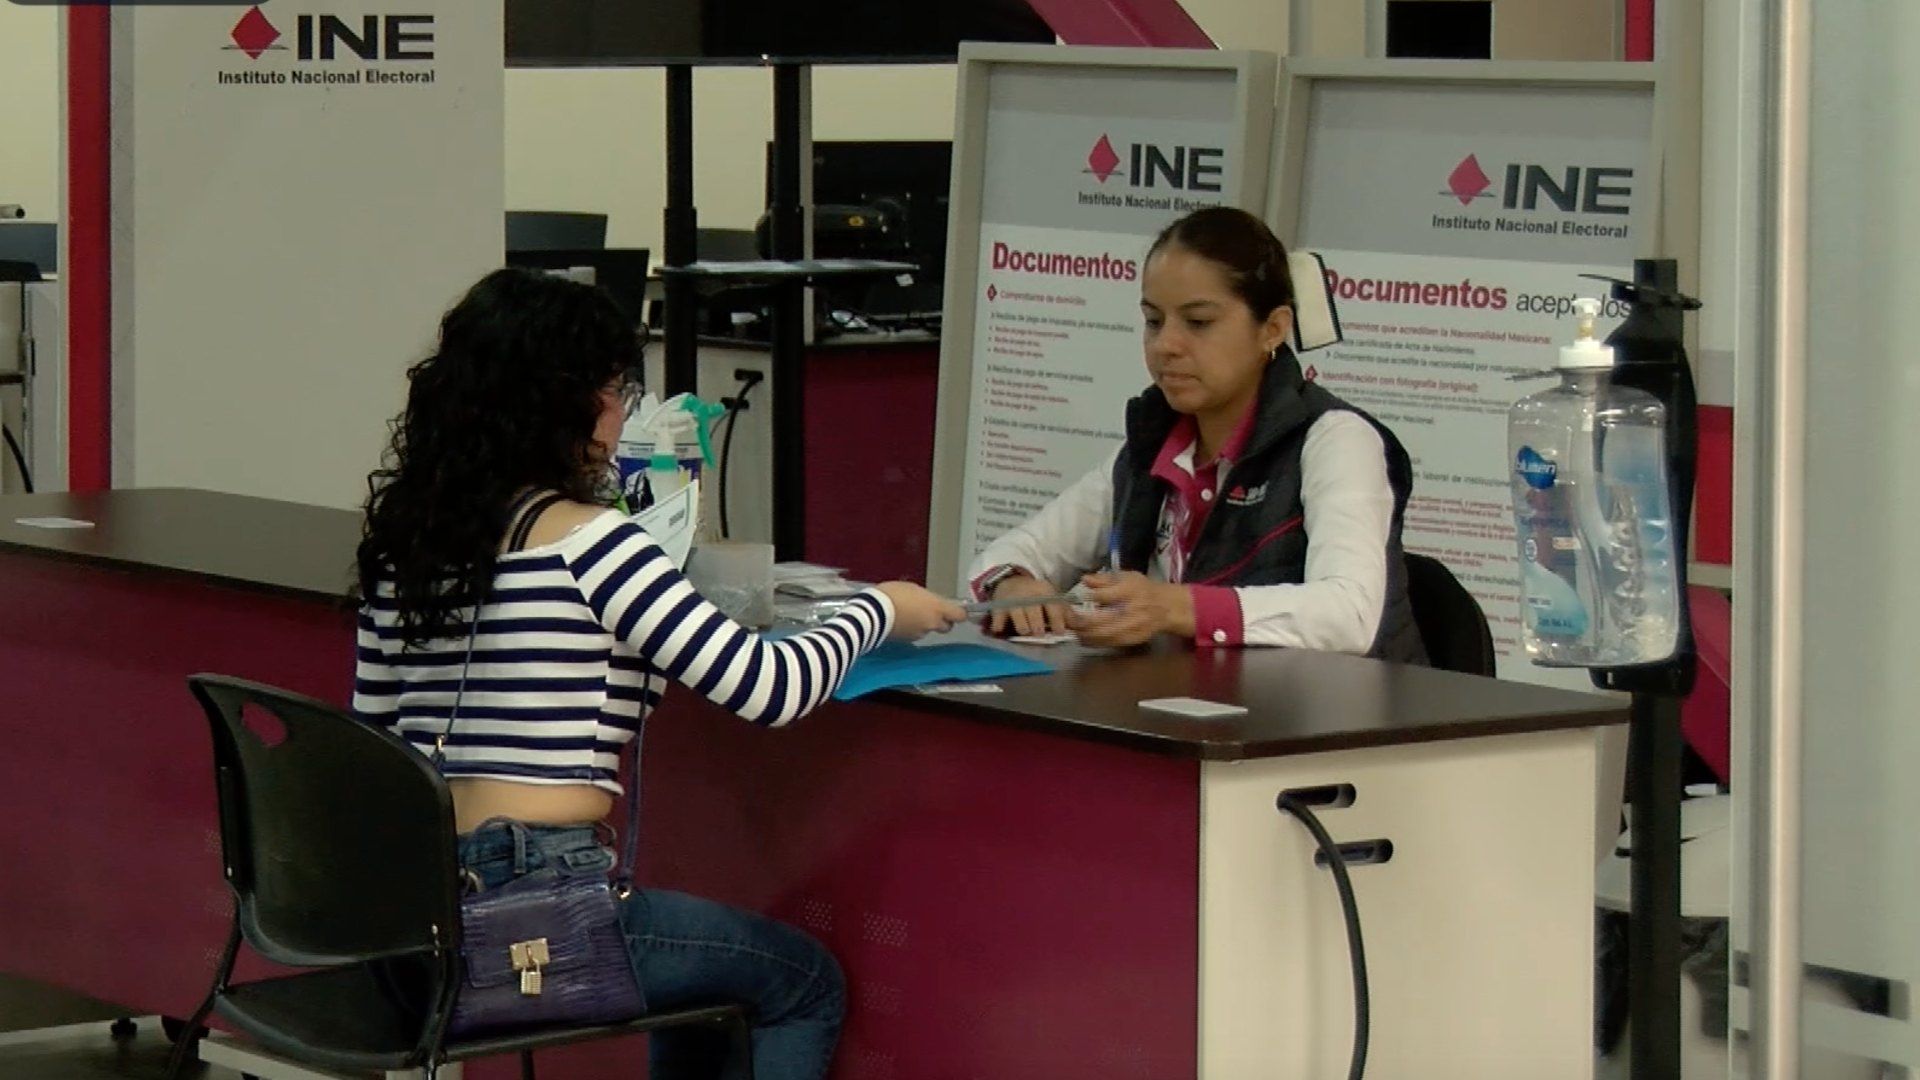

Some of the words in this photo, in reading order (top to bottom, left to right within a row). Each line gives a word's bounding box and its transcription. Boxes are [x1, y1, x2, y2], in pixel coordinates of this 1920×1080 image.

[298, 15, 434, 60] INE
[218, 70, 286, 84] Instituto
[291, 70, 360, 84] Nacional
[366, 70, 435, 84] Electoral
[1130, 143, 1224, 192] INE
[1078, 191, 1122, 207] Instituto
[1125, 194, 1171, 211] Nacional
[1503, 163, 1633, 215] INE
[1432, 215, 1491, 231] Instituto
[1495, 218, 1557, 235] Nacional
[1562, 220, 1628, 238] Electoral
[992, 242, 1137, 282] Documentos
[1516, 293, 1633, 320] aceptdos
